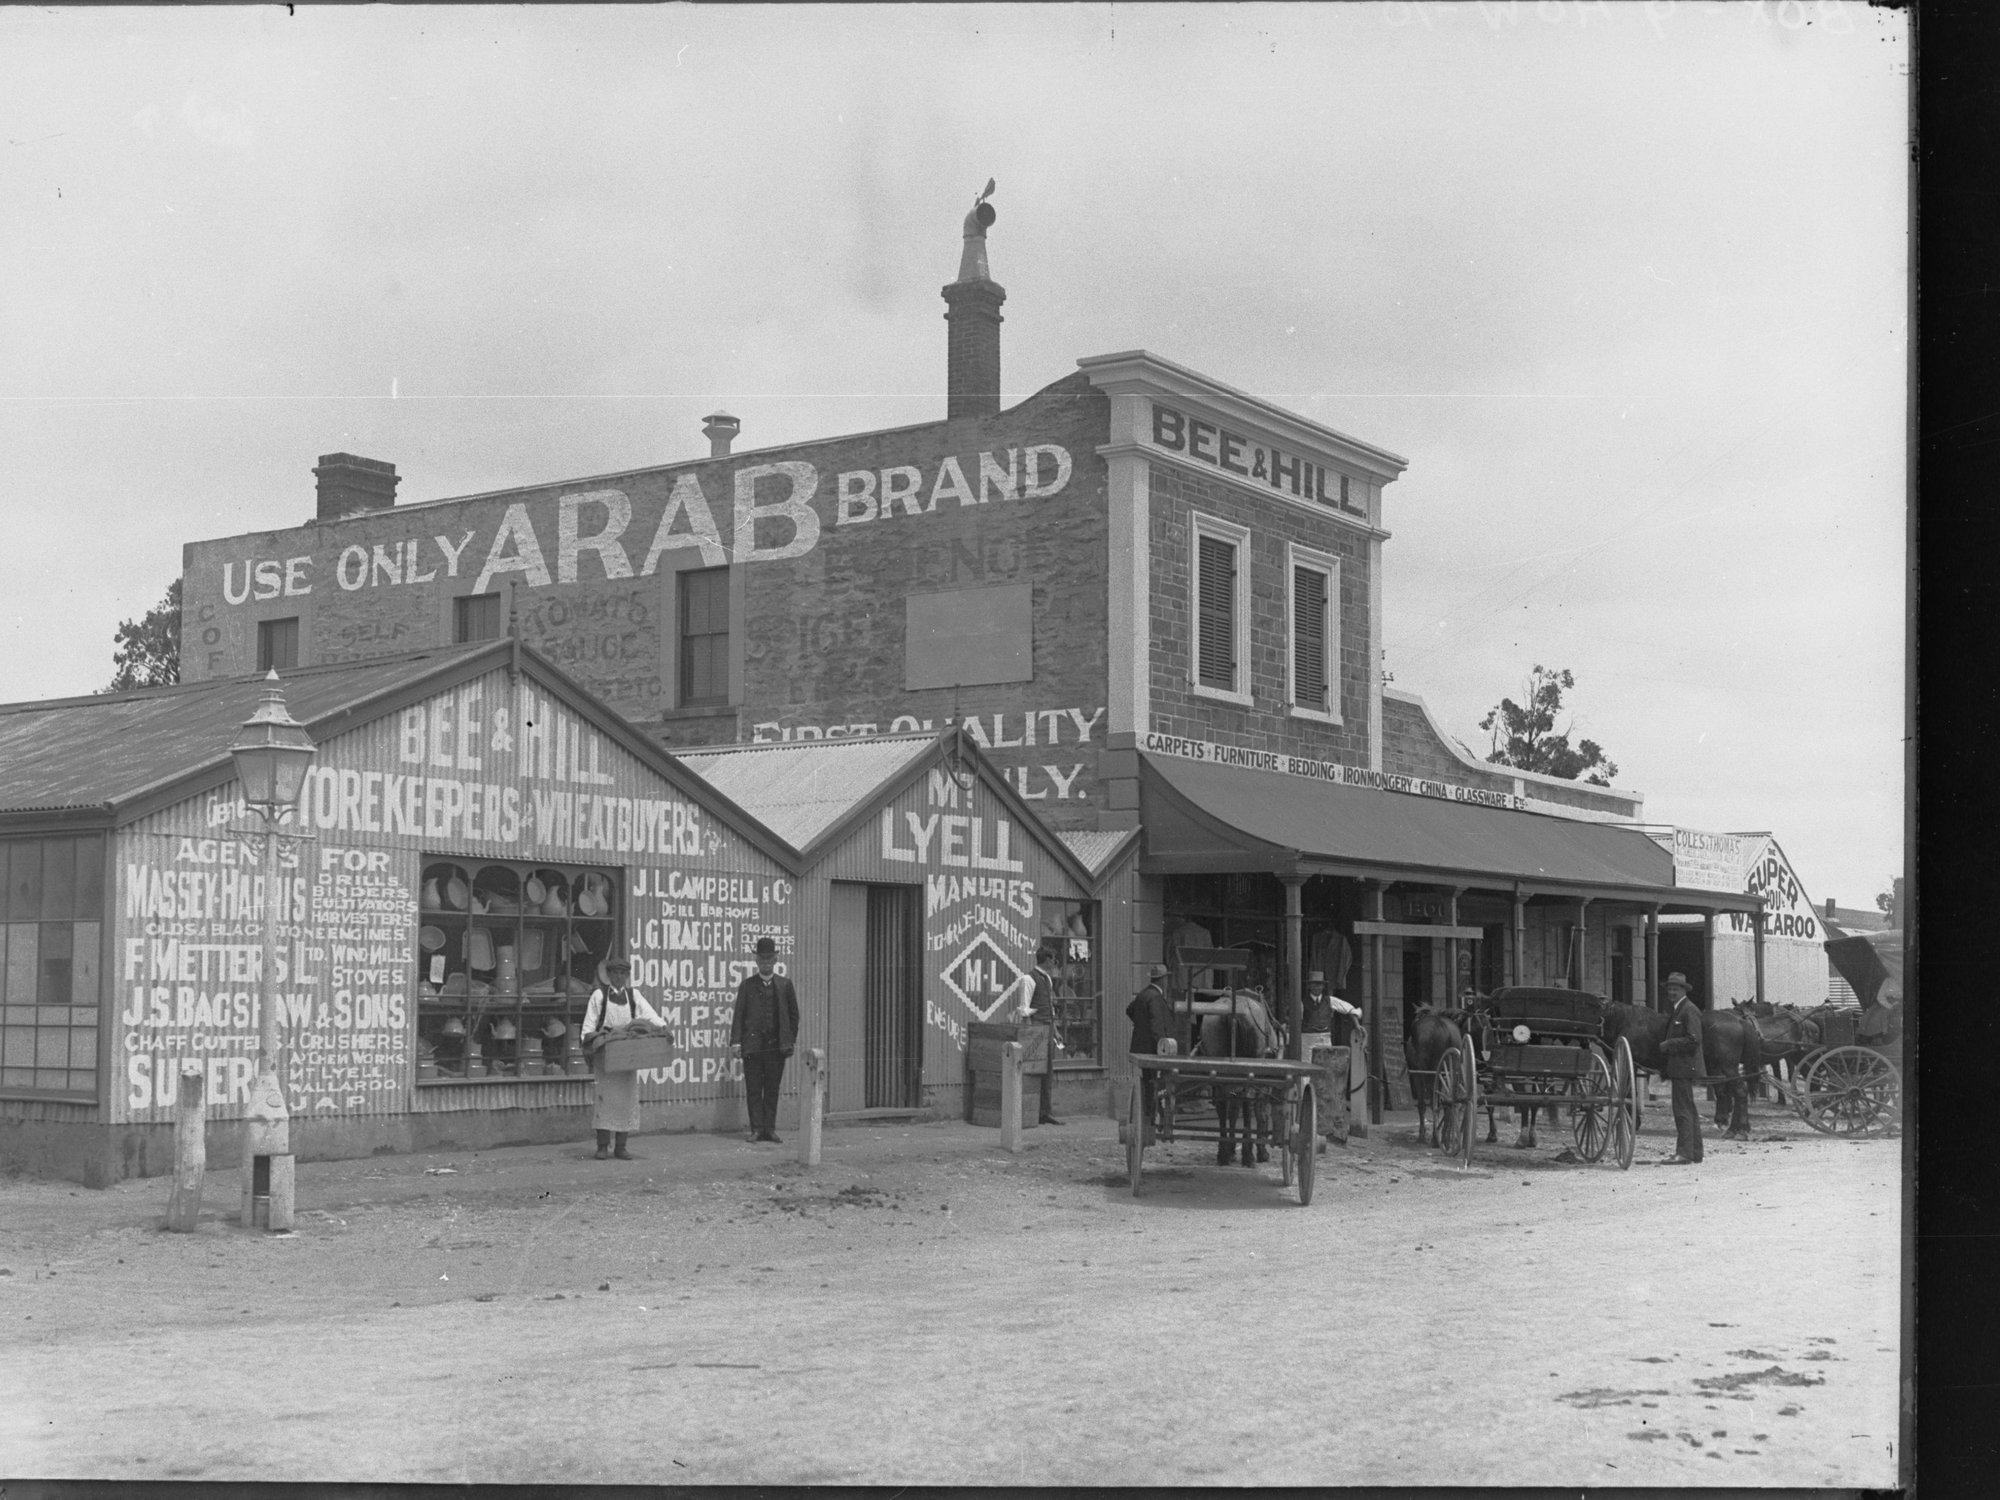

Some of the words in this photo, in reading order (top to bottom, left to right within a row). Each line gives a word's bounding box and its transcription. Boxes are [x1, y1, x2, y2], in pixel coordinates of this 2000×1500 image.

[1152, 403, 1249, 477] BEE
[1251, 448, 1268, 481] &
[223, 556, 314, 605] USE
[336, 530, 476, 591] ONLY
[471, 460, 821, 595] ARAB
[835, 444, 1073, 526] BRAND
[400, 682, 482, 771] BEE
[491, 707, 514, 752] &
[1146, 733, 1205, 759] CARPETS
[1213, 744, 1279, 771] FURNITURE
[1287, 757, 1336, 781] BEDDING
[1343, 767, 1414, 793] IRONMONGERY
[1419, 780, 1448, 798] CHINA
[1454, 787, 1507, 808] GLASSWARE
[277, 764, 520, 843] TOREKEEPERS
[173, 838, 299, 868] AGENS
[321, 848, 391, 872] FOR
[881, 806, 1024, 874] LYELL
[1675, 829, 1706, 850] COLES
[127, 864, 306, 922] MASSEY-HARIS
[927, 874, 1034, 919] MANURES
[1748, 857, 1798, 911] SUPER
[211, 923, 325, 940] BLACKTONE
[1730, 912, 1816, 939] WALAROO
[630, 954, 694, 989] DOMO
[314, 1001, 333, 1030] &
[334, 989, 406, 1030] SONS
[124, 1031, 188, 1052] CHAFF
